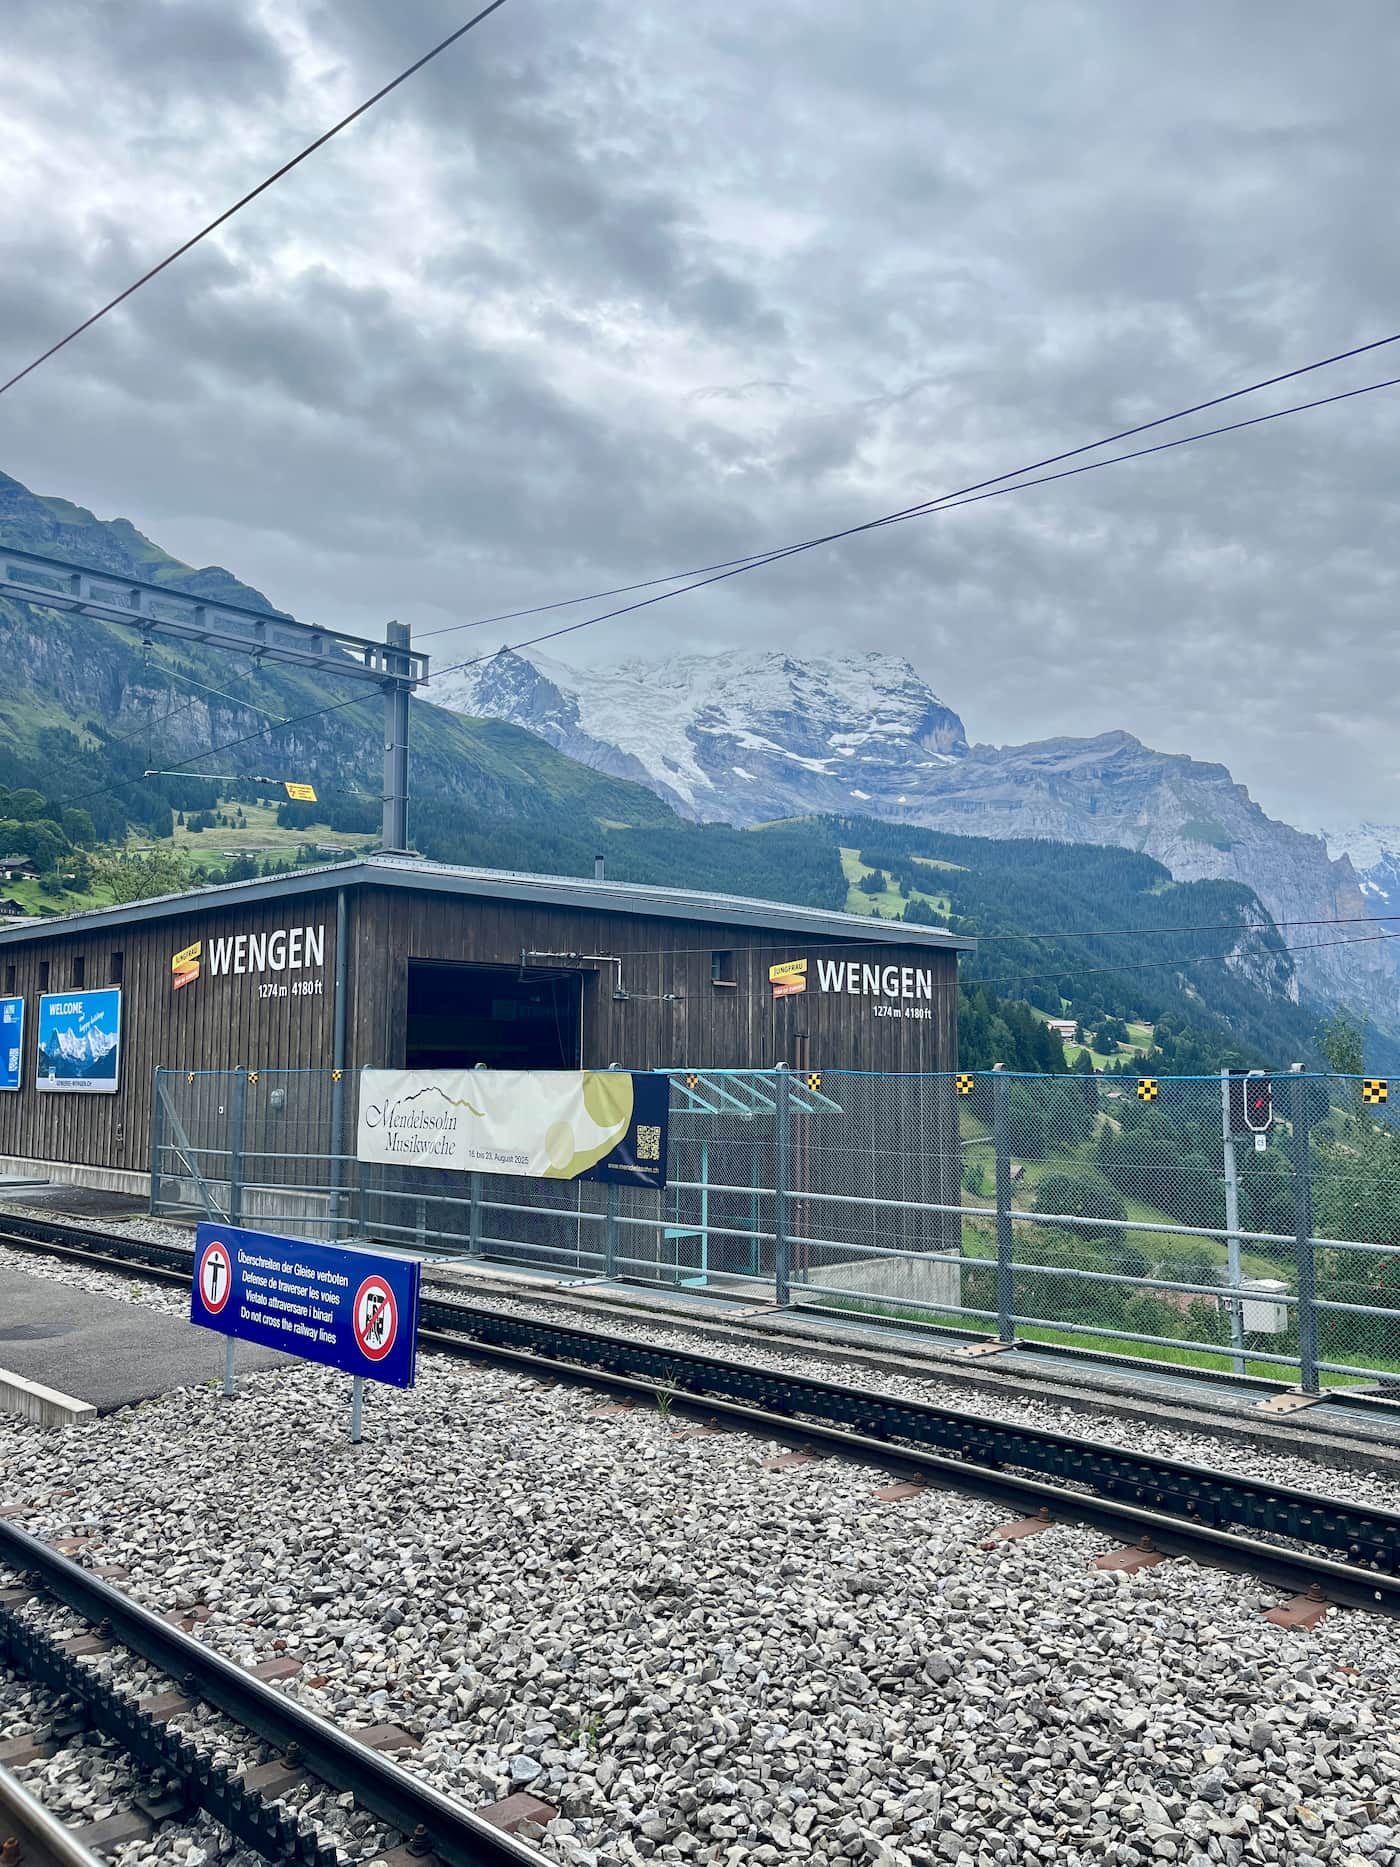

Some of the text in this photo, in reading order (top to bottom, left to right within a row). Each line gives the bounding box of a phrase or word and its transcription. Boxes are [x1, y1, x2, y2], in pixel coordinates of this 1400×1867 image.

[209, 925, 325, 976] WENGEN
[773, 963, 802, 976] JUNGFRAU
[816, 960, 932, 1000] WENGEN
[49, 1001, 83, 1016] WELCOME
[366, 1099, 457, 1130] Mendelssohn
[384, 1132, 456, 1156] Musikwoche
[494, 1152, 514, 1164] August
[514, 1155, 529, 1165] 2025
[237, 1249, 349, 1287] Überschreiten der Gleise verboten
[242, 1270, 341, 1305] Defense de traverser les voies
[246, 1289, 334, 1324] Vietato attraversare i binari
[240, 1306, 337, 1344] Do not cross the railway lines
